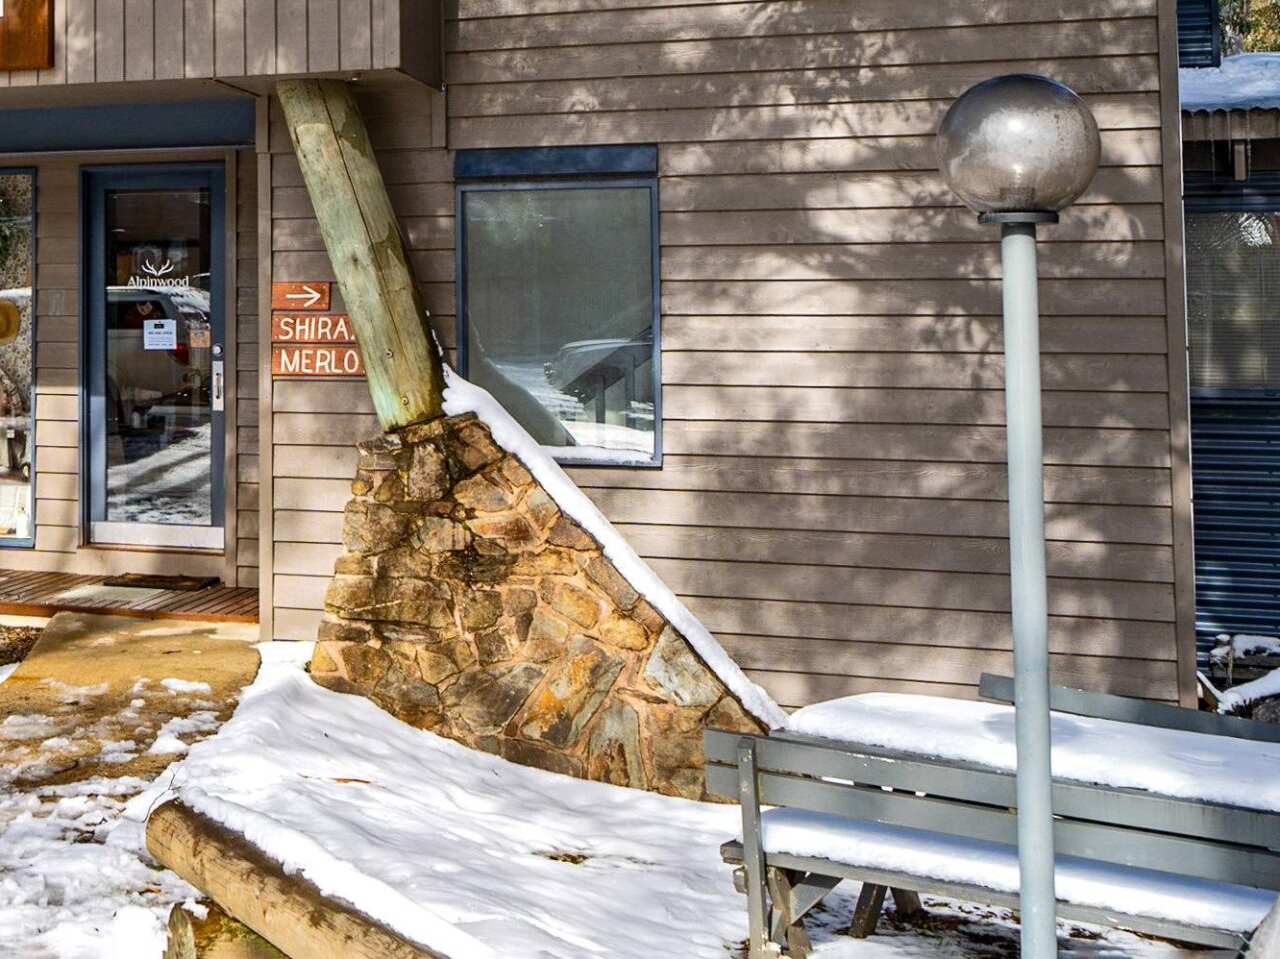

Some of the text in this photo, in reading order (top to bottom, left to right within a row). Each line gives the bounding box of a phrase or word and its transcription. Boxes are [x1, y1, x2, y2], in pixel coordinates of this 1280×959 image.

[127, 275, 189, 289] Alpinwood
[278, 317, 356, 340] SHIRA
[281, 349, 360, 373] MERLO
